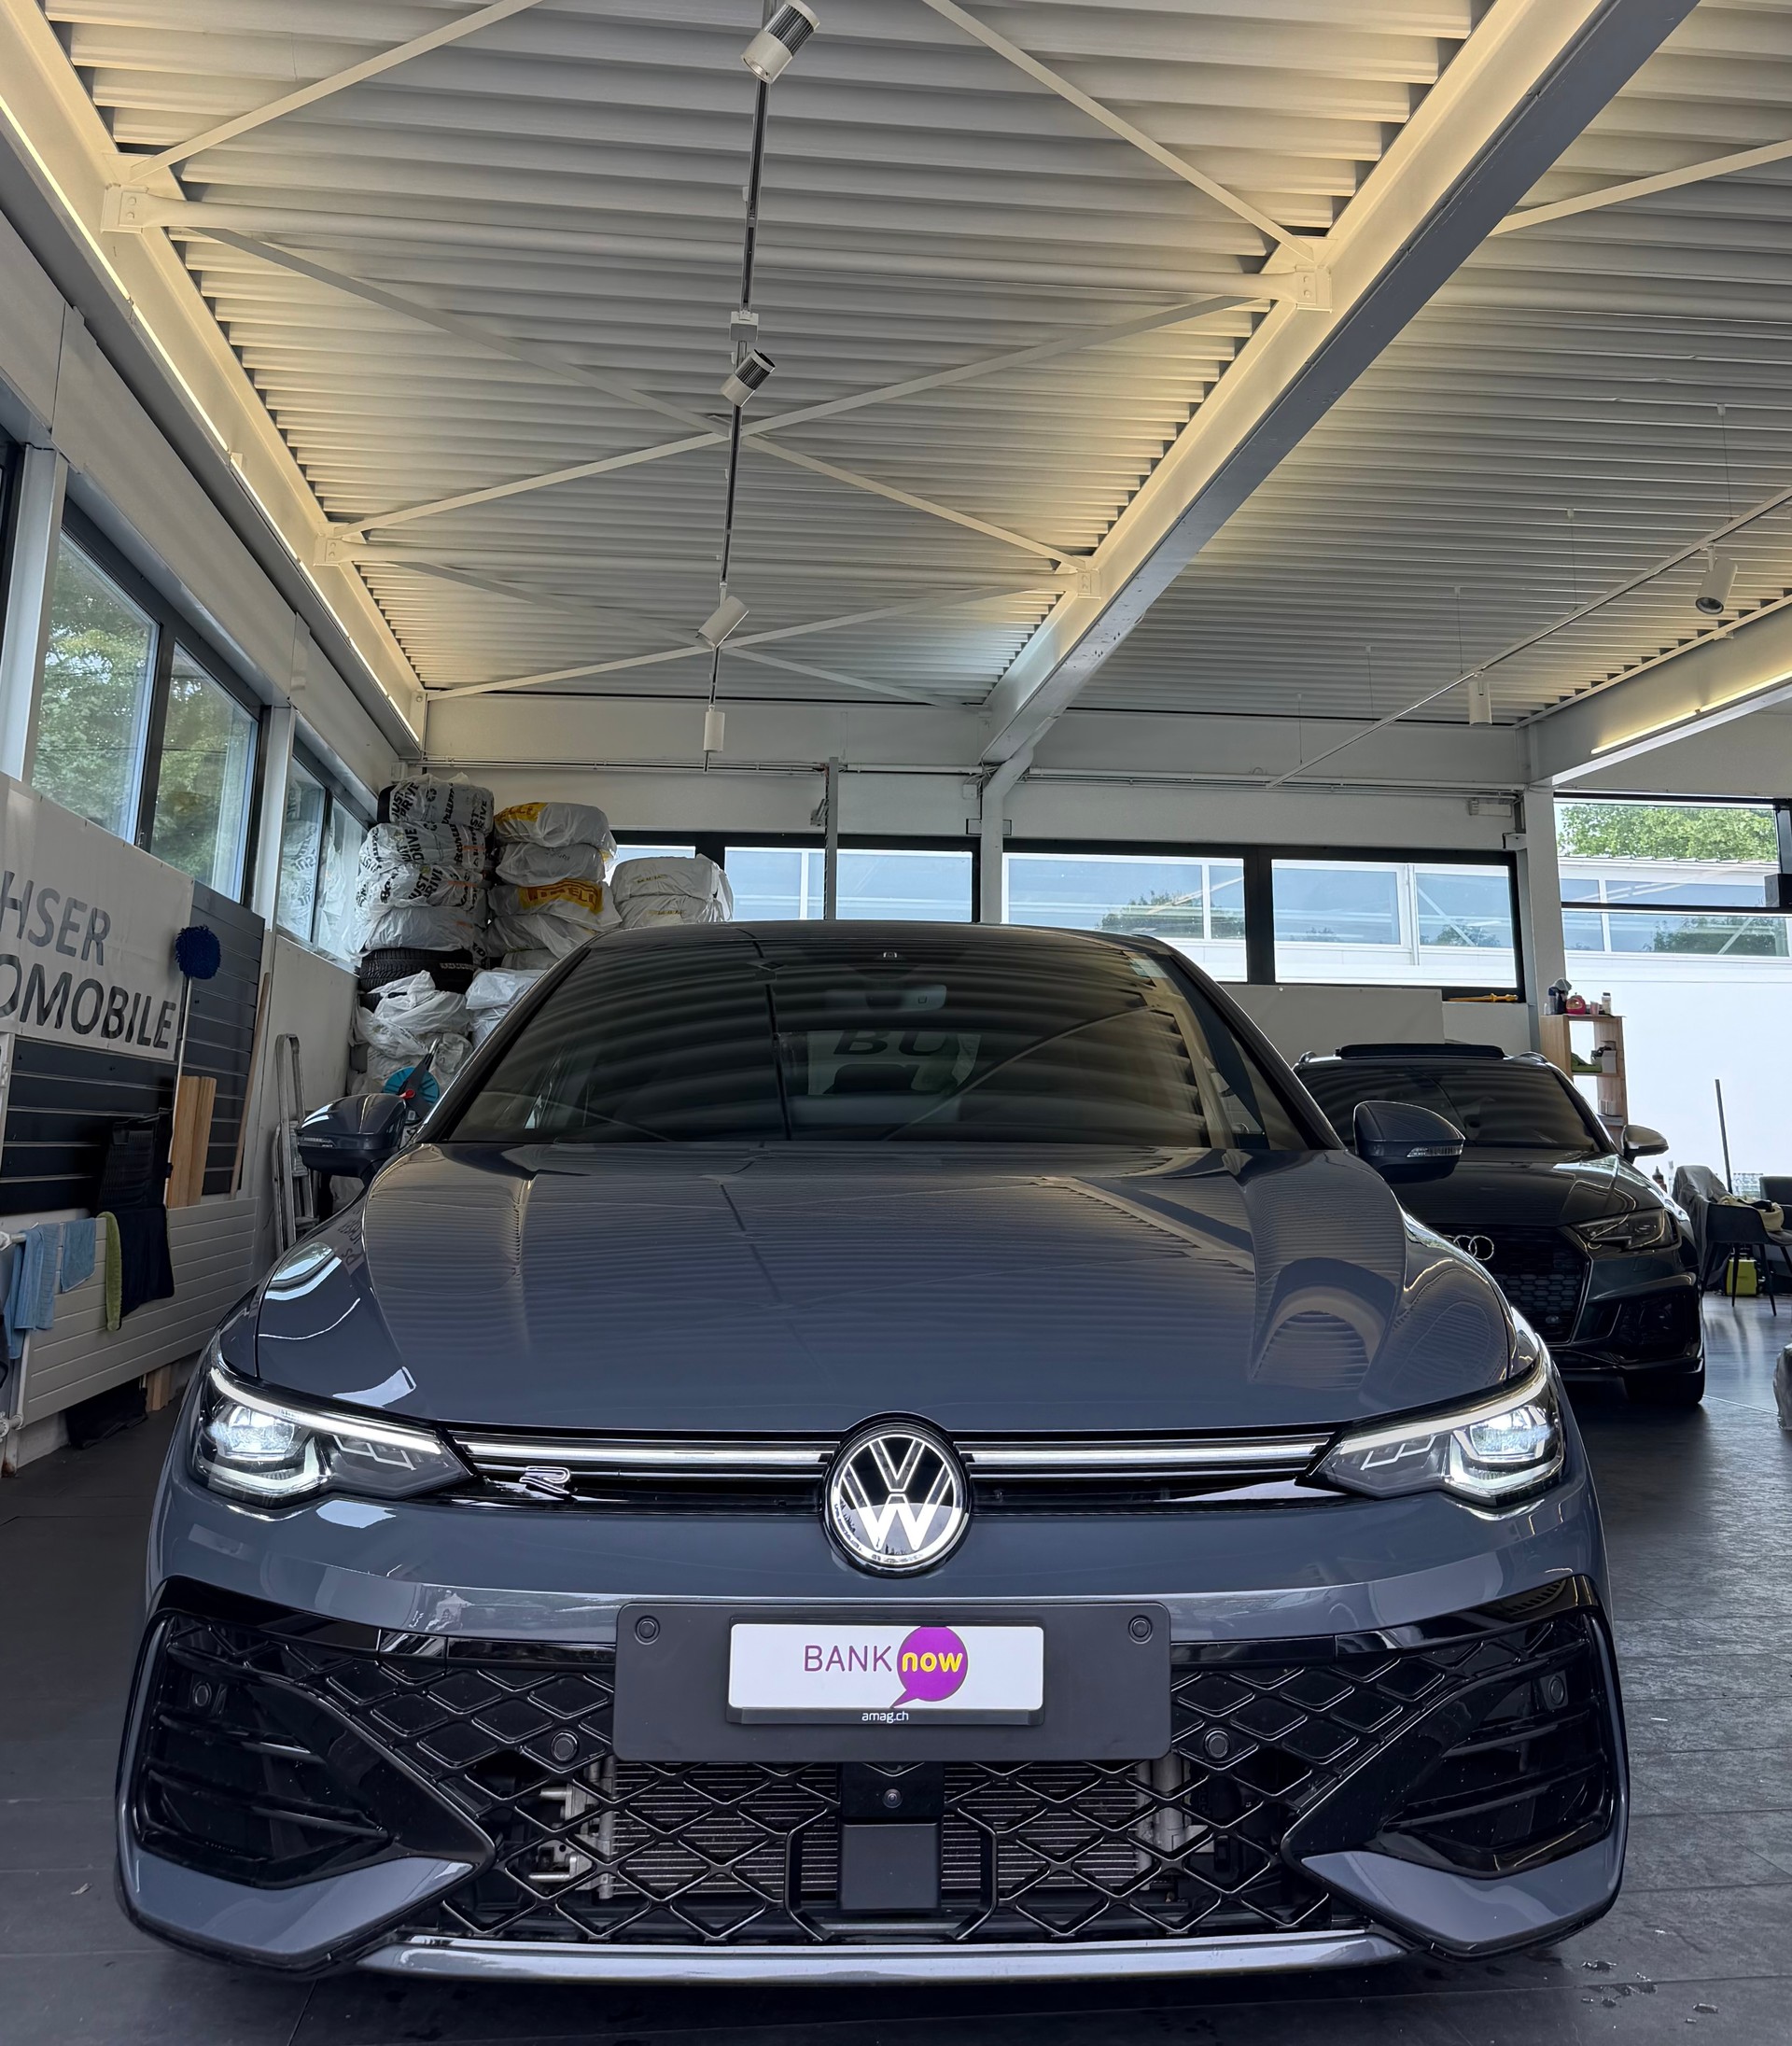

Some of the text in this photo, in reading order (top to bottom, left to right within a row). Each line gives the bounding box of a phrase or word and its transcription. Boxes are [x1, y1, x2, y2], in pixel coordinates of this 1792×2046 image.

[0, 870, 111, 966] HSER
[0, 953, 176, 1050] OMOBILE
[804, 1645, 963, 1674] BANK now
[861, 1710, 909, 1724] amag.ch
